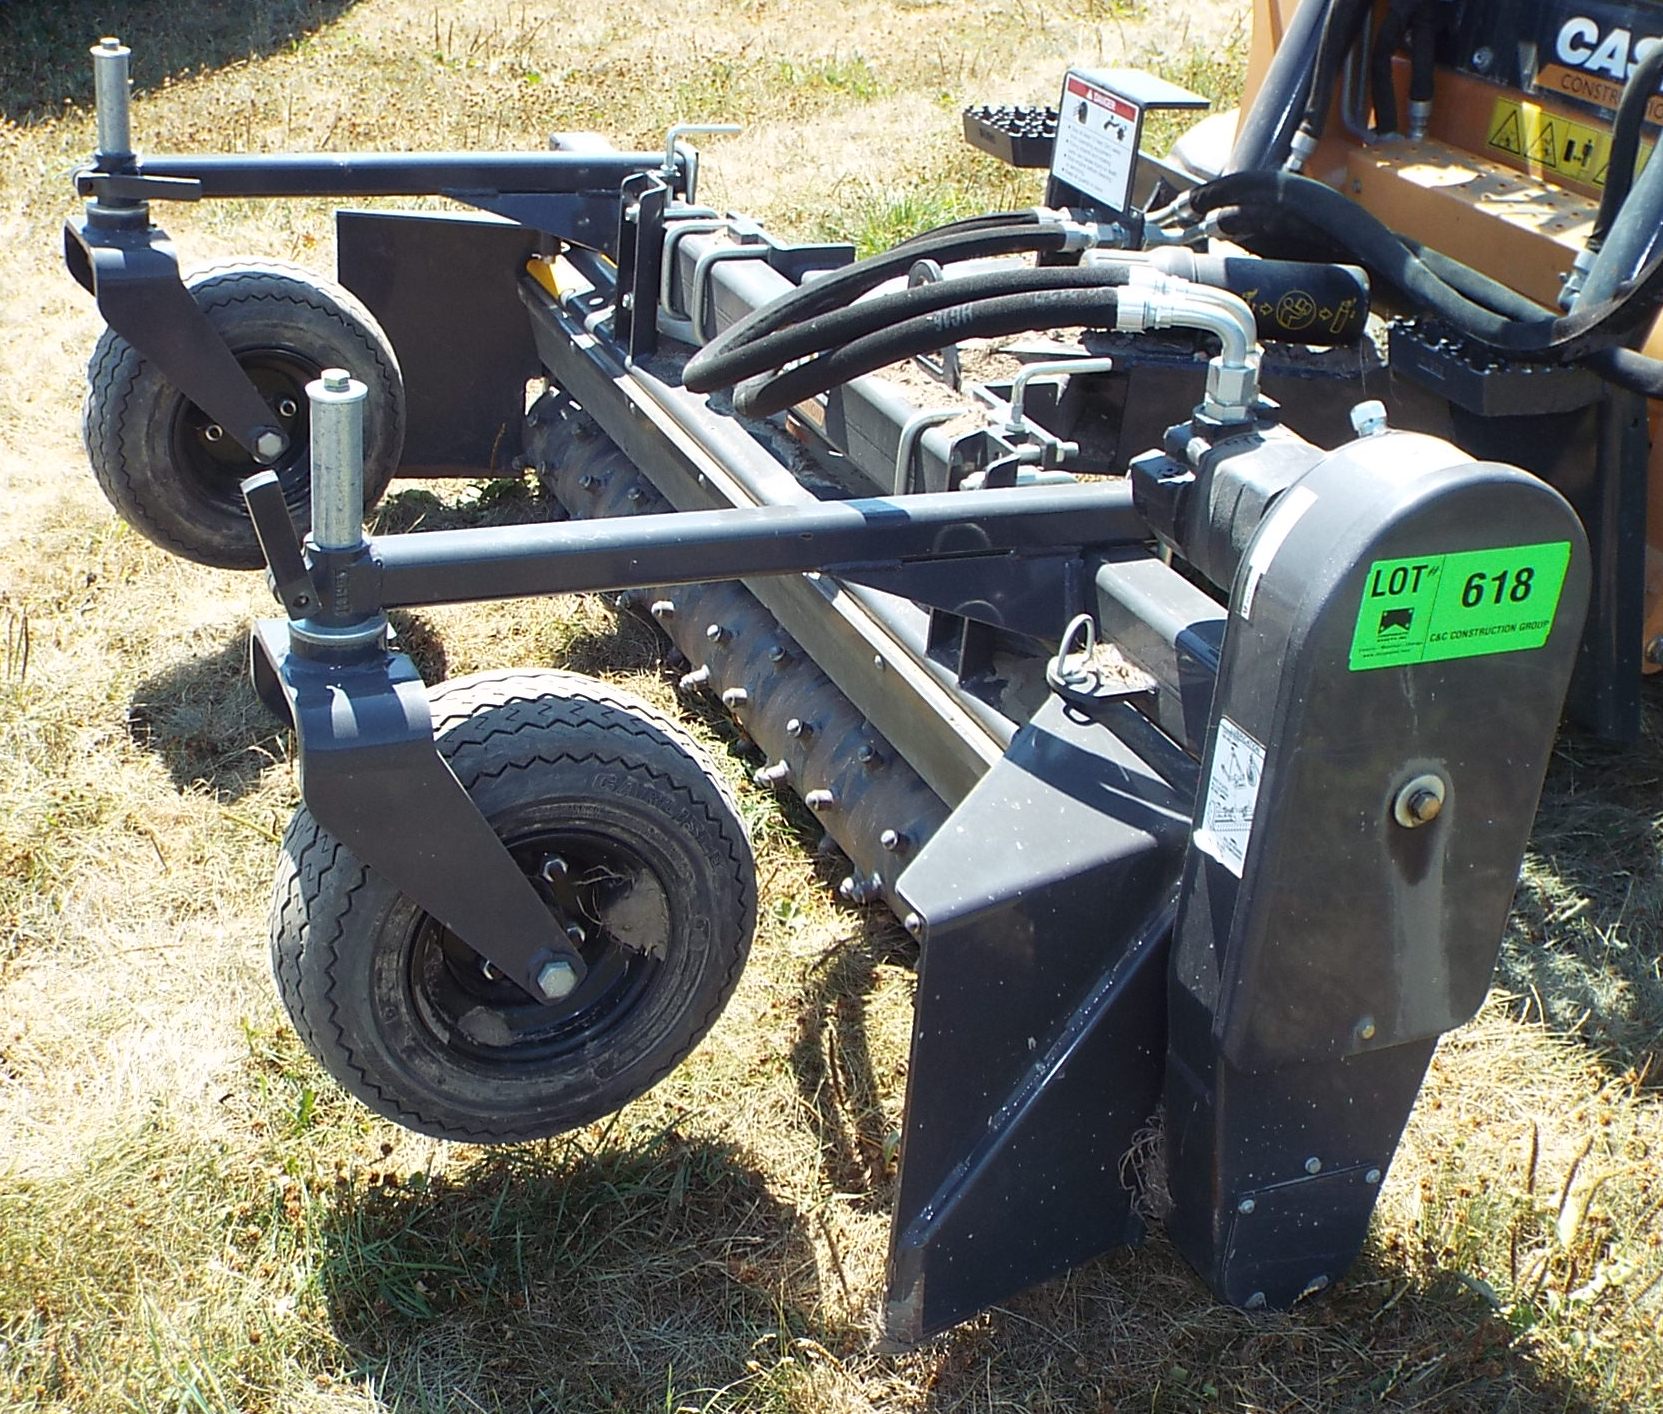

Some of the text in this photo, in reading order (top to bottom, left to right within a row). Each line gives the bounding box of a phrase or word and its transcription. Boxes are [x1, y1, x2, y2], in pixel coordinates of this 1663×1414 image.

[1461, 566, 1535, 609] 618
[1429, 620, 1550, 643] C&C CONSTRUCTION GROUP
